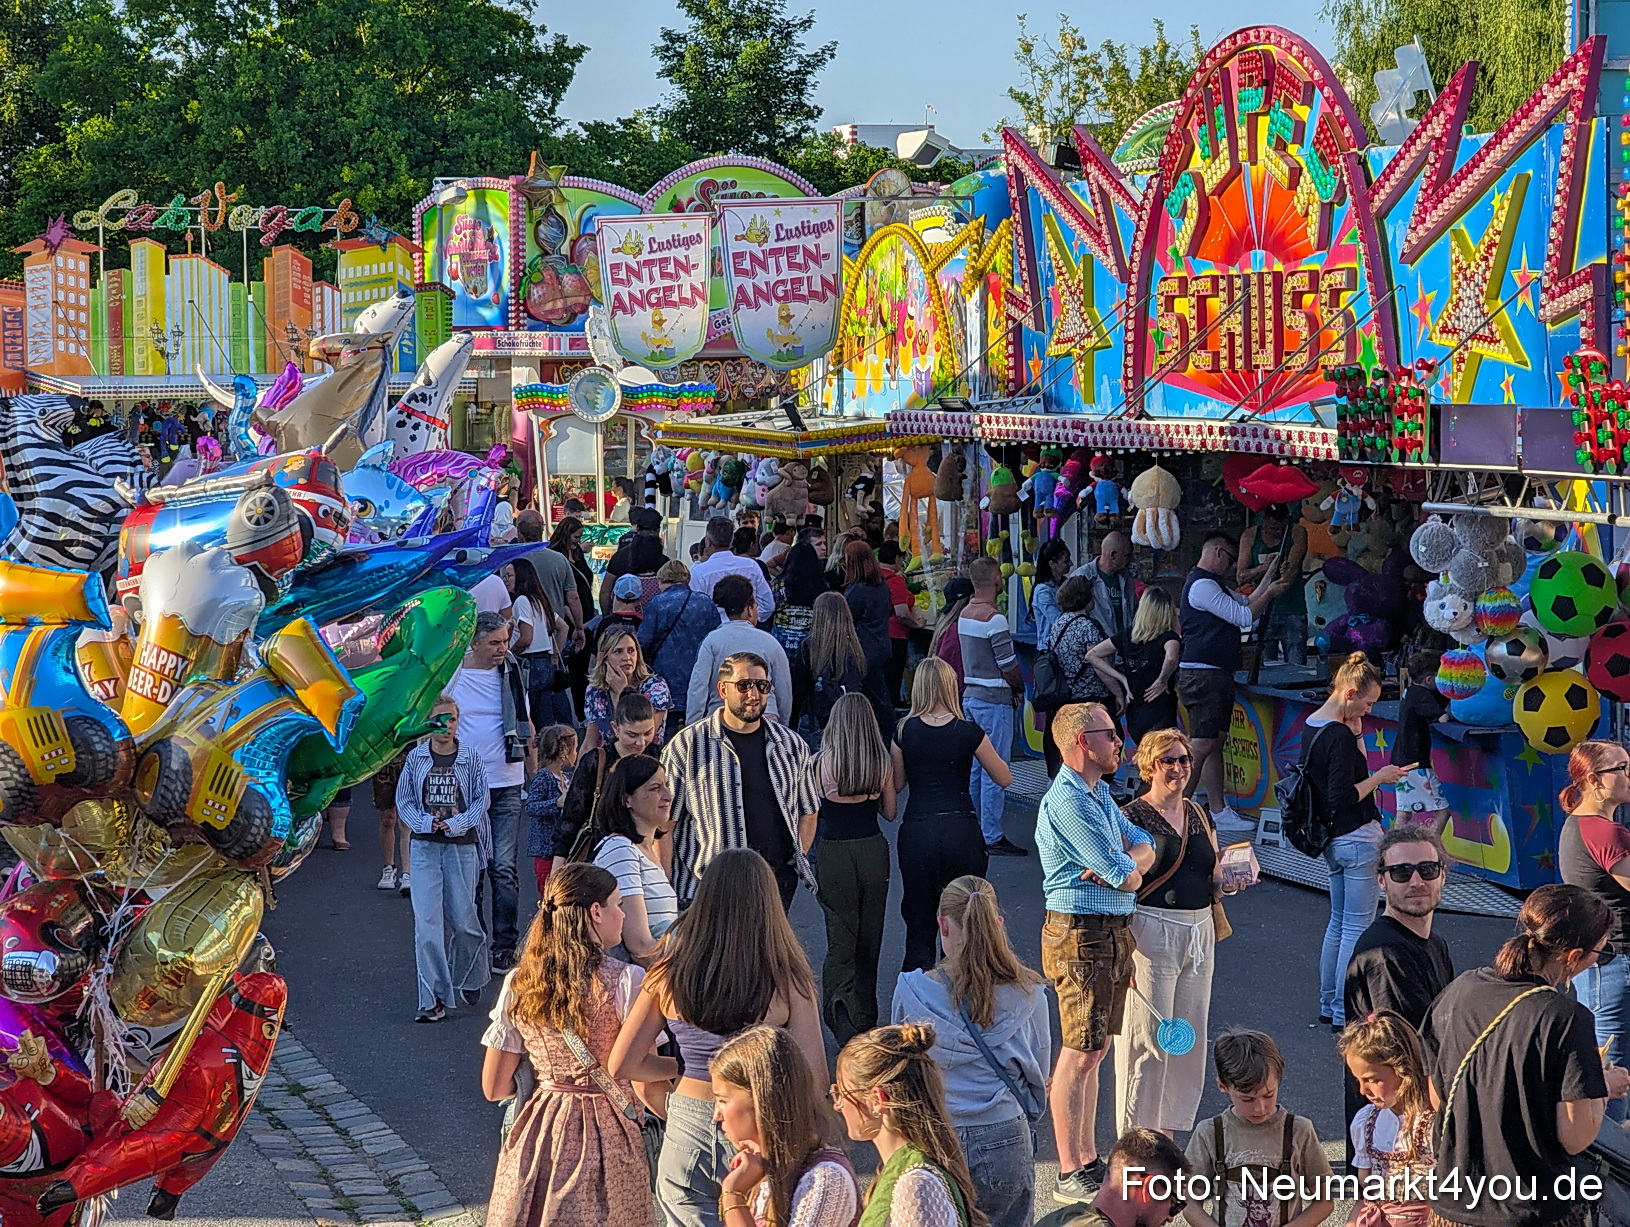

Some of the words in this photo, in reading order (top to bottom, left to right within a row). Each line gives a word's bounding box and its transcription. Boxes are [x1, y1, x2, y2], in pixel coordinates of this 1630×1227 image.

[1162, 48, 1348, 258] SUPER
[72, 188, 192, 231] Las
[190, 181, 359, 246] Vegas
[774, 219, 835, 242] Lustiges
[647, 232, 703, 254] Lustiges
[609, 254, 700, 288] ENTEN-
[732, 243, 831, 280] ENTEN-
[424, 298, 435, 320] THE
[610, 281, 708, 319] ANGELN
[732, 273, 840, 314] ANGELN
[1156, 266, 1358, 374] SCHUSS
[497, 338, 543, 348] Schokofrüchte
[828, 431, 886, 447] LUSTIGE
[140, 643, 189, 680] HAPPY
[429, 776, 456, 785] HEART
[429, 785, 438, 794] OF
[440, 785, 455, 794] THE
